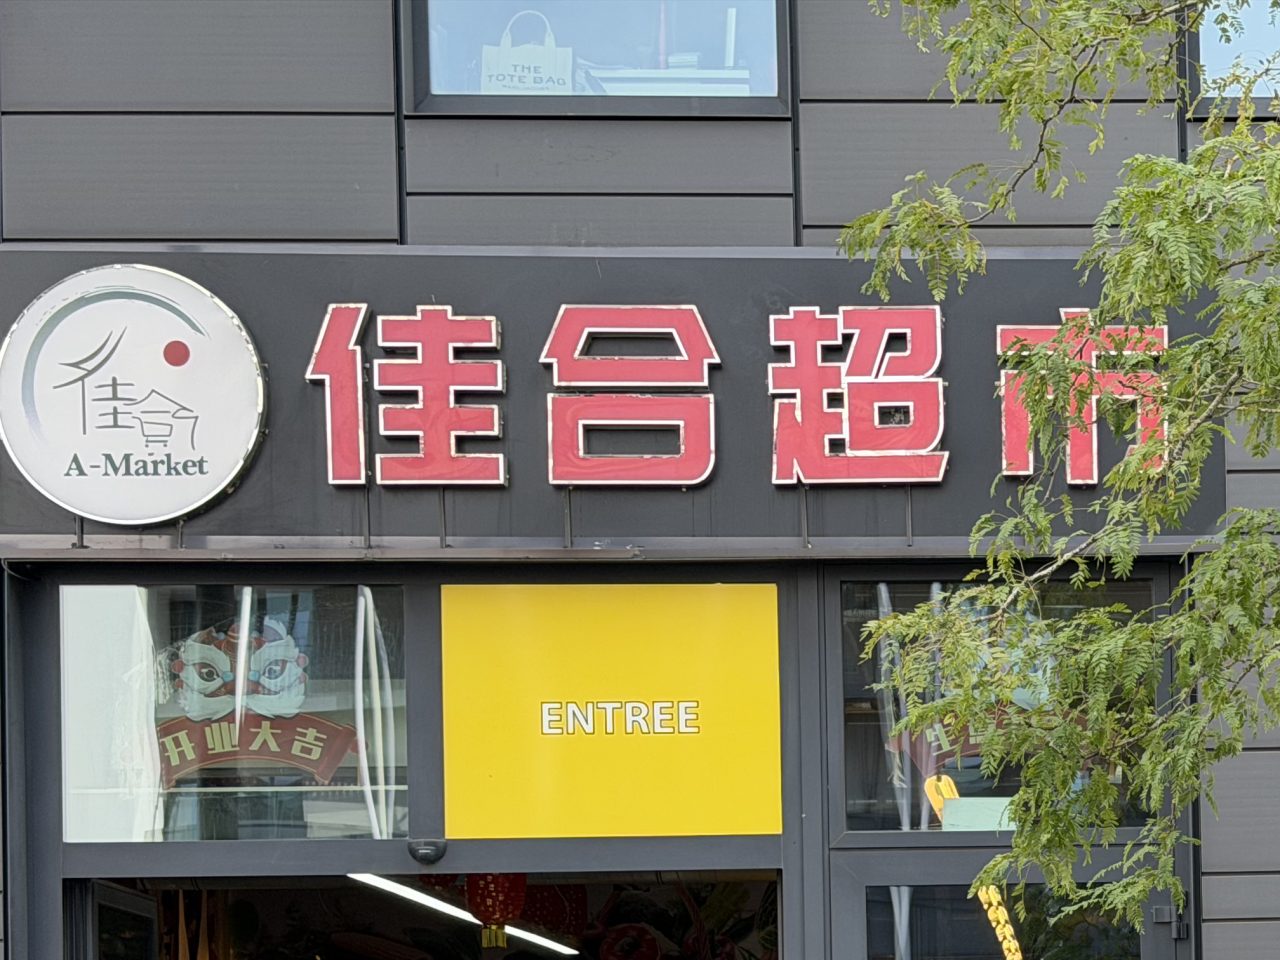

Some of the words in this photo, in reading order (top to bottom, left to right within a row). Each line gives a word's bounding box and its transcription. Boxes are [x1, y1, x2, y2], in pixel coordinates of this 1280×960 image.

[487, 73, 528, 84] TOTE
[532, 76, 567, 87] BAG
[511, 64, 543, 75] THE
[305, 303, 1169, 485] 佳合超市
[64, 452, 209, 477] A-Market
[540, 700, 701, 736] ENTREE
[159, 720, 328, 767] 开业大吉
